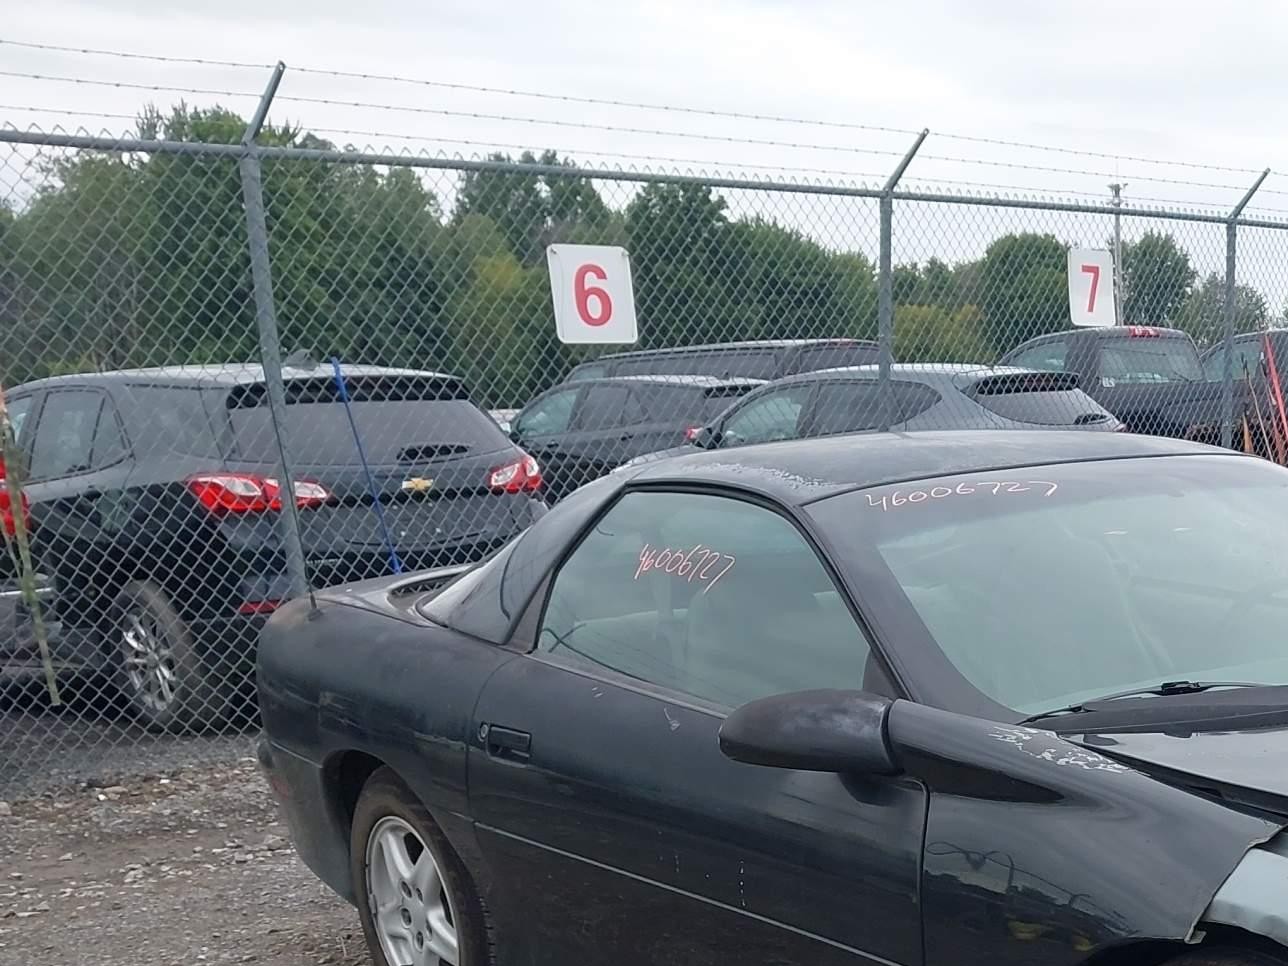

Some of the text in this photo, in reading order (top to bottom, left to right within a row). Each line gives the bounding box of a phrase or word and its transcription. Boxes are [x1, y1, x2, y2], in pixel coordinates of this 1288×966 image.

[574, 263, 613, 328] 6
[1081, 264, 1101, 313] 7
[865, 480, 1058, 511] 46006727
[634, 543, 736, 594] 46006727
